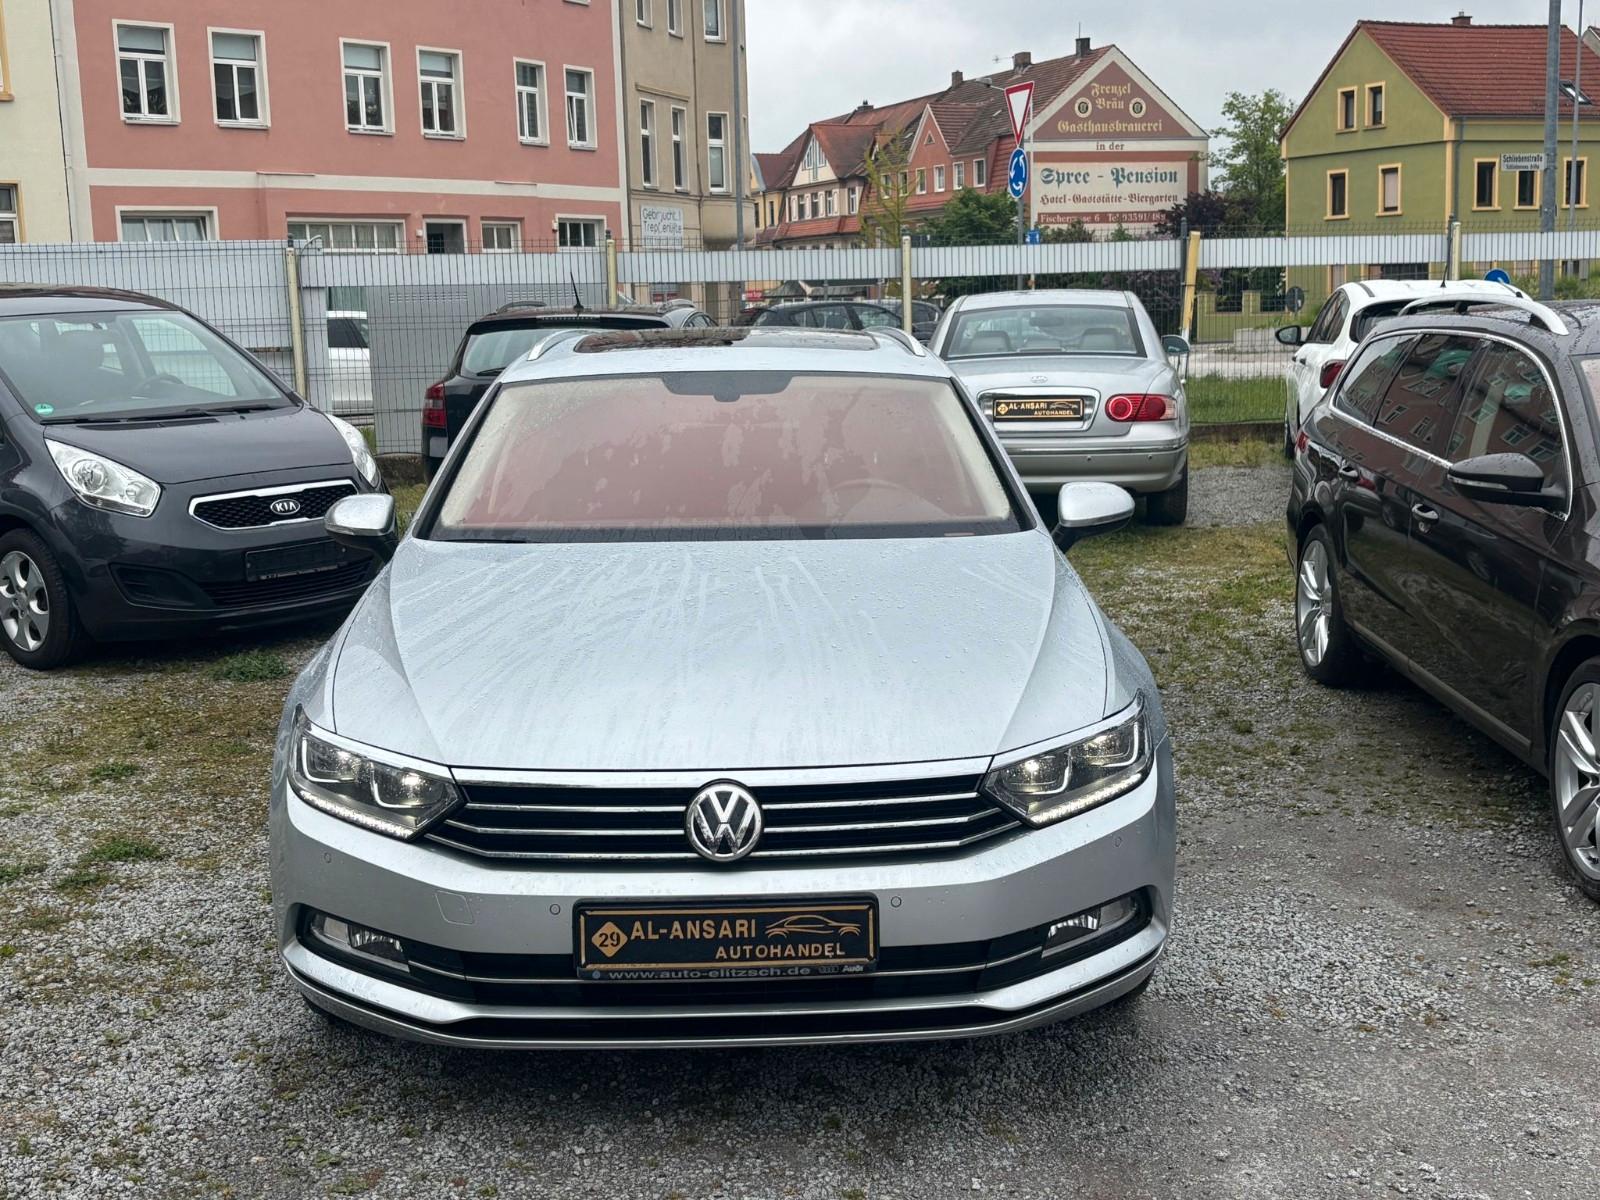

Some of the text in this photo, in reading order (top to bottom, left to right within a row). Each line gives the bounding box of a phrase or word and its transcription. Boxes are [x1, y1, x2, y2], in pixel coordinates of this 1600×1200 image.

[1091, 83, 1131, 97] Frenzel
[1096, 97, 1124, 109] Bräu
[1057, 119, 1163, 134] Gasthausbrauerei
[1096, 141, 1125, 151] in der
[1040, 167, 1091, 189] Spree
[1110, 166, 1178, 189] Pension
[1094, 213, 1101, 223] 6
[1009, 402, 1047, 410] AL-ANSARI
[275, 502, 297, 512] KIA
[598, 919, 757, 948] 29 AL-ANSARI
[714, 942, 846, 960] AUTOHANDEL
[609, 966, 811, 980] www.auto-elitzsch.de
